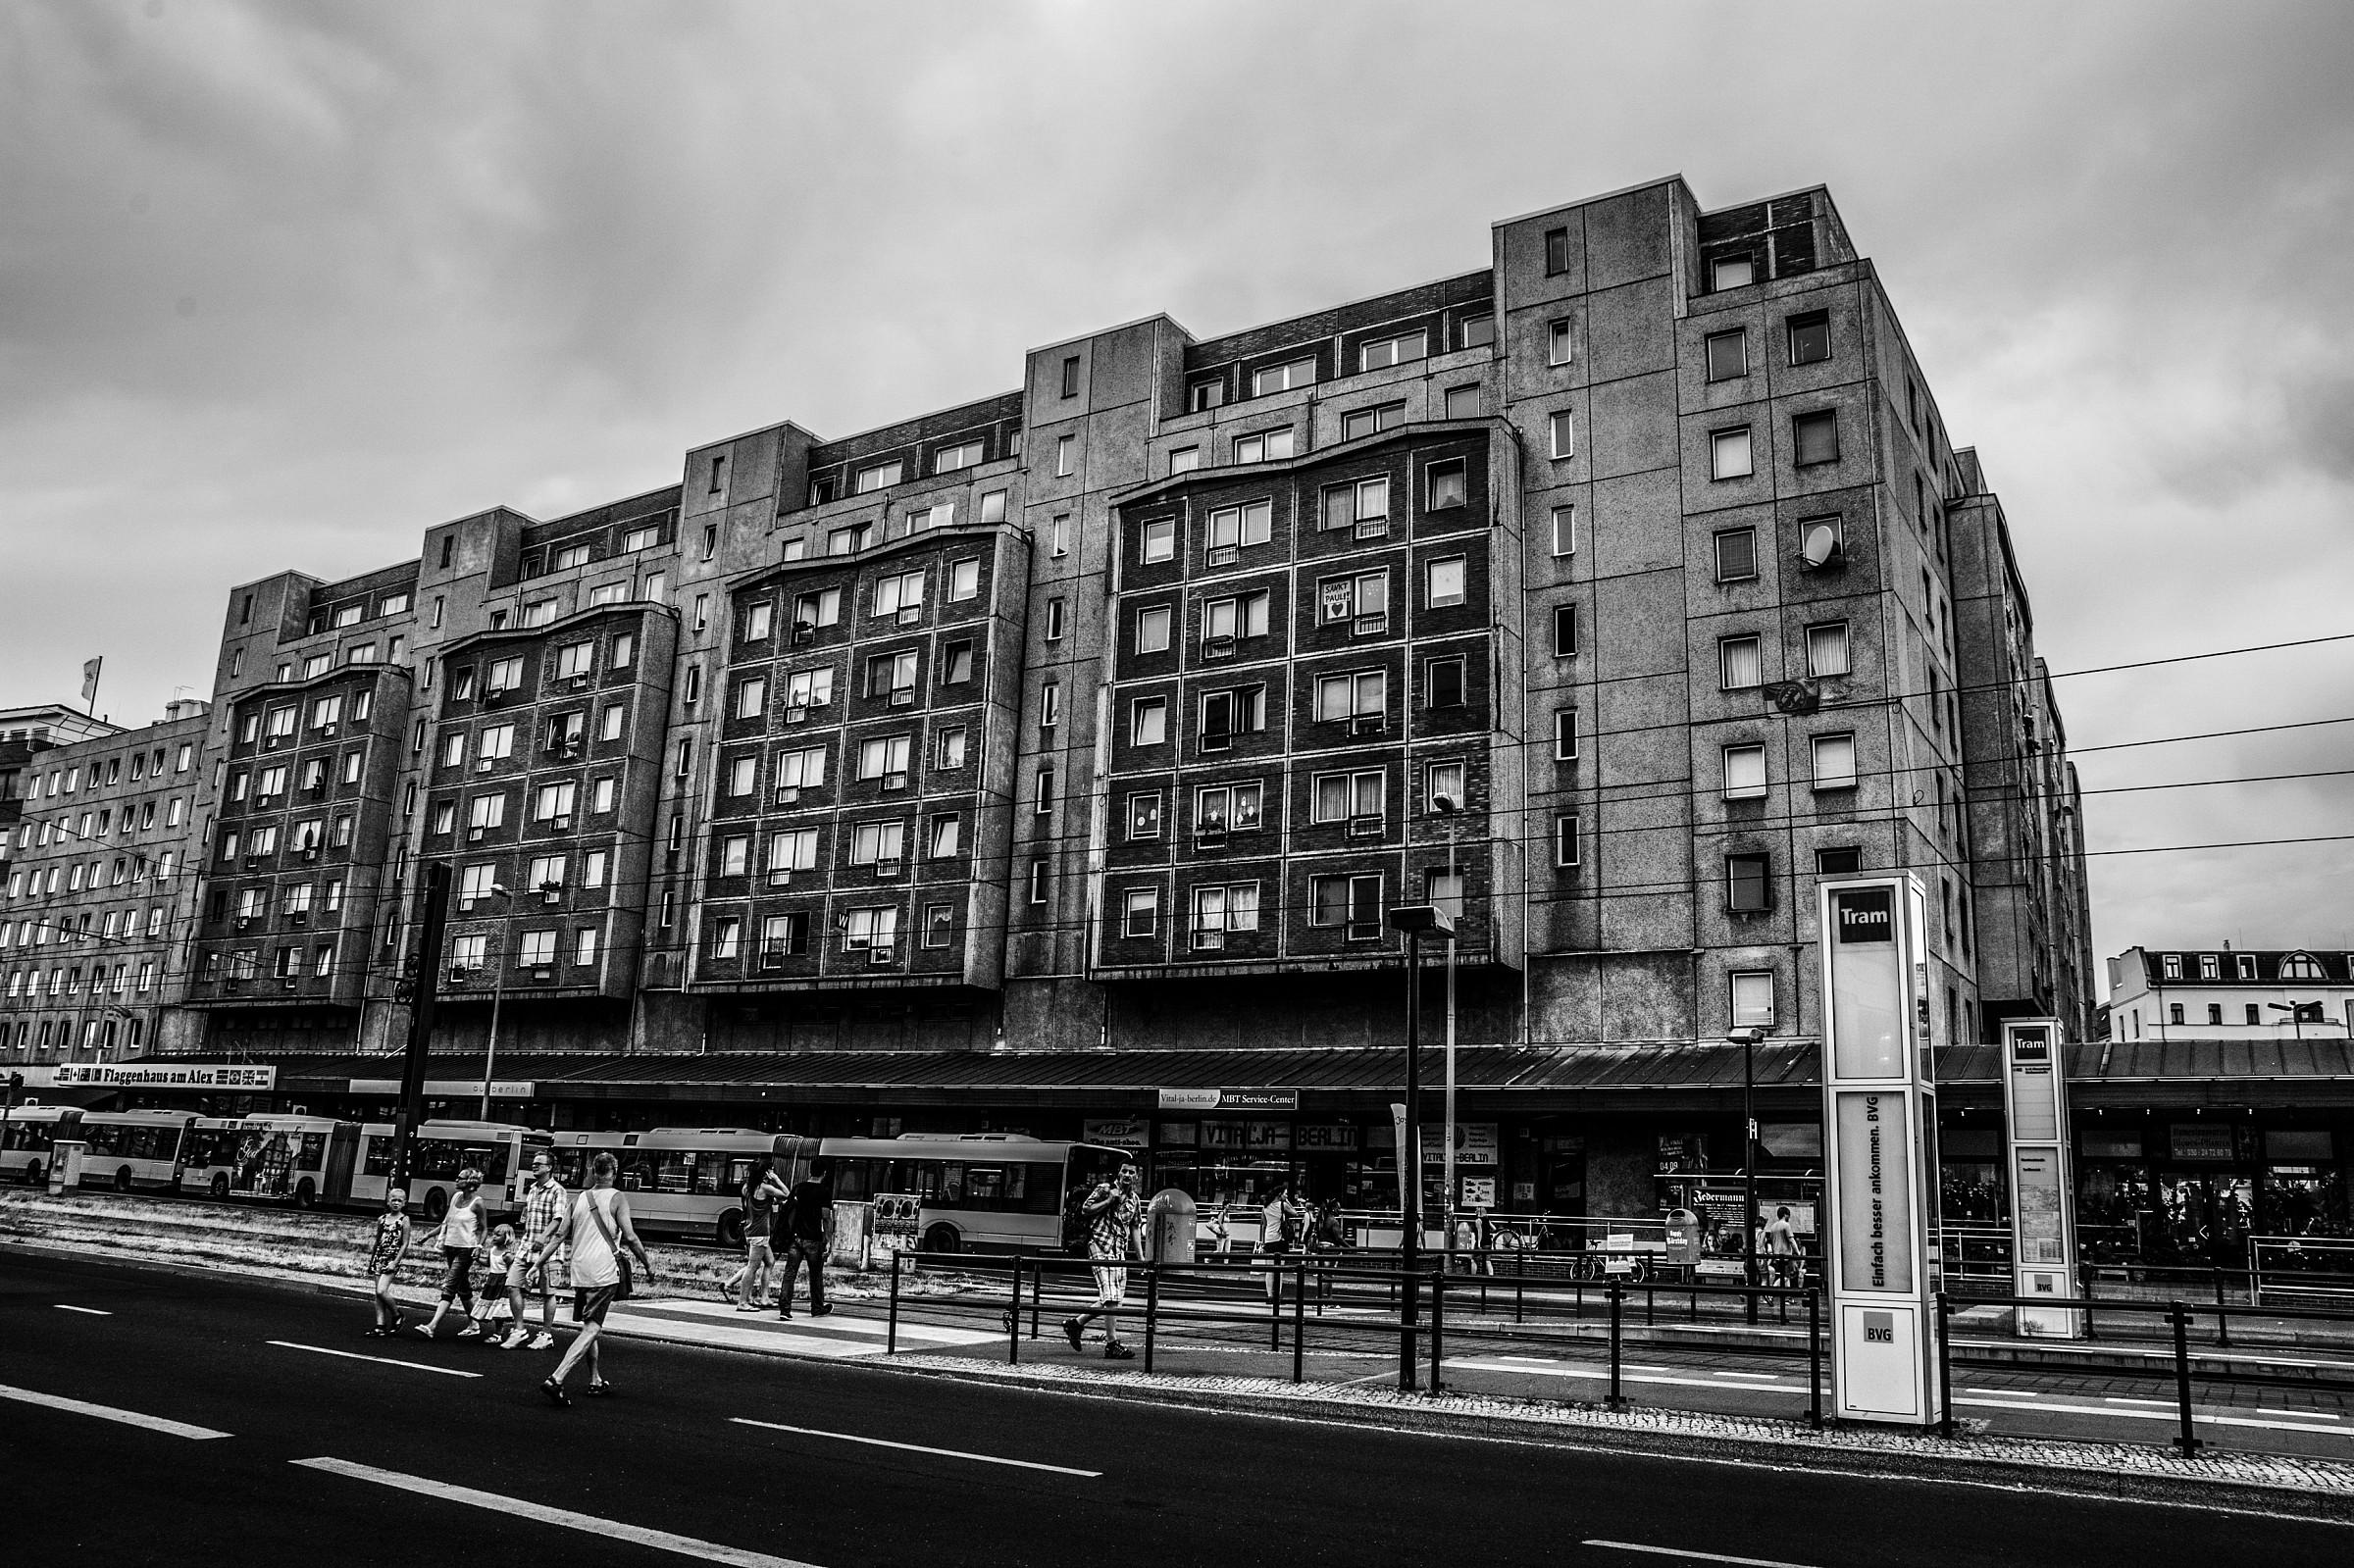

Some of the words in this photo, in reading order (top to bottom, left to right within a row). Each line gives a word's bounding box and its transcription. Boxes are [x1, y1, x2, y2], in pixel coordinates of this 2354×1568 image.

[1325, 582, 1348, 593] SANKT
[1325, 591, 1351, 603] PAULI!
[1841, 907, 1888, 925] Tram
[2016, 1038, 2045, 1048] Tram
[103, 1068, 169, 1086] Flaggenhaus
[171, 1073, 186, 1084] am
[188, 1069, 214, 1085] Alex
[1160, 1093, 1217, 1104] Vital-ja-berlin.de
[1221, 1094, 1240, 1103] MBT
[1242, 1094, 1295, 1103] Service-Center
[1867, 1096, 1879, 1122] BVG
[1099, 1124, 1135, 1135] MBT
[1868, 1125, 1881, 1194] ankommen.
[1693, 1189, 1745, 1203] Jedermann
[1869, 1198, 1883, 1239] besser
[1870, 1241, 1884, 1288] Einfach
[1868, 1328, 1892, 1341] BVG
